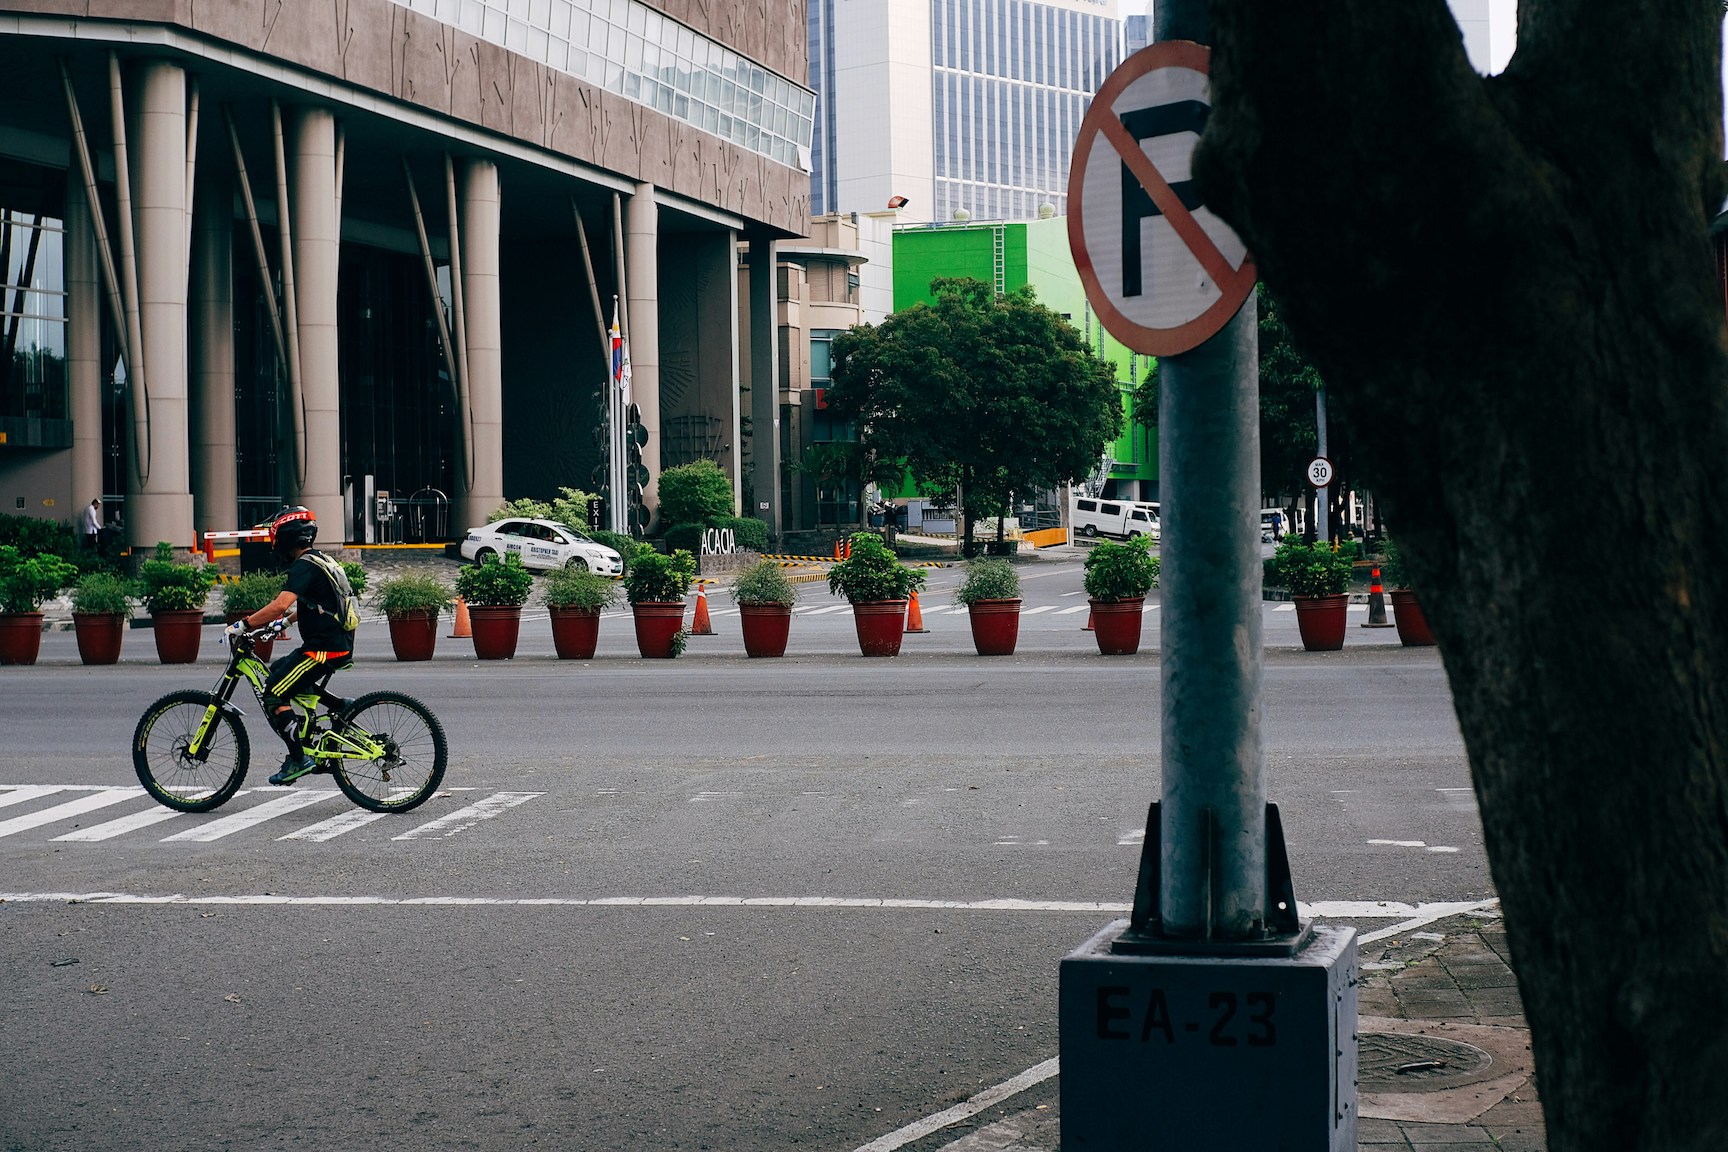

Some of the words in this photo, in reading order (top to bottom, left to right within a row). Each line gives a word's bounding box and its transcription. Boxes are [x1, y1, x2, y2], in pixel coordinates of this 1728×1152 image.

[1313, 467, 1327, 478] 30
[592, 500, 600, 532] EXIT
[701, 527, 736, 555] ACACIA
[1096, 985, 1276, 1047] EA-23
